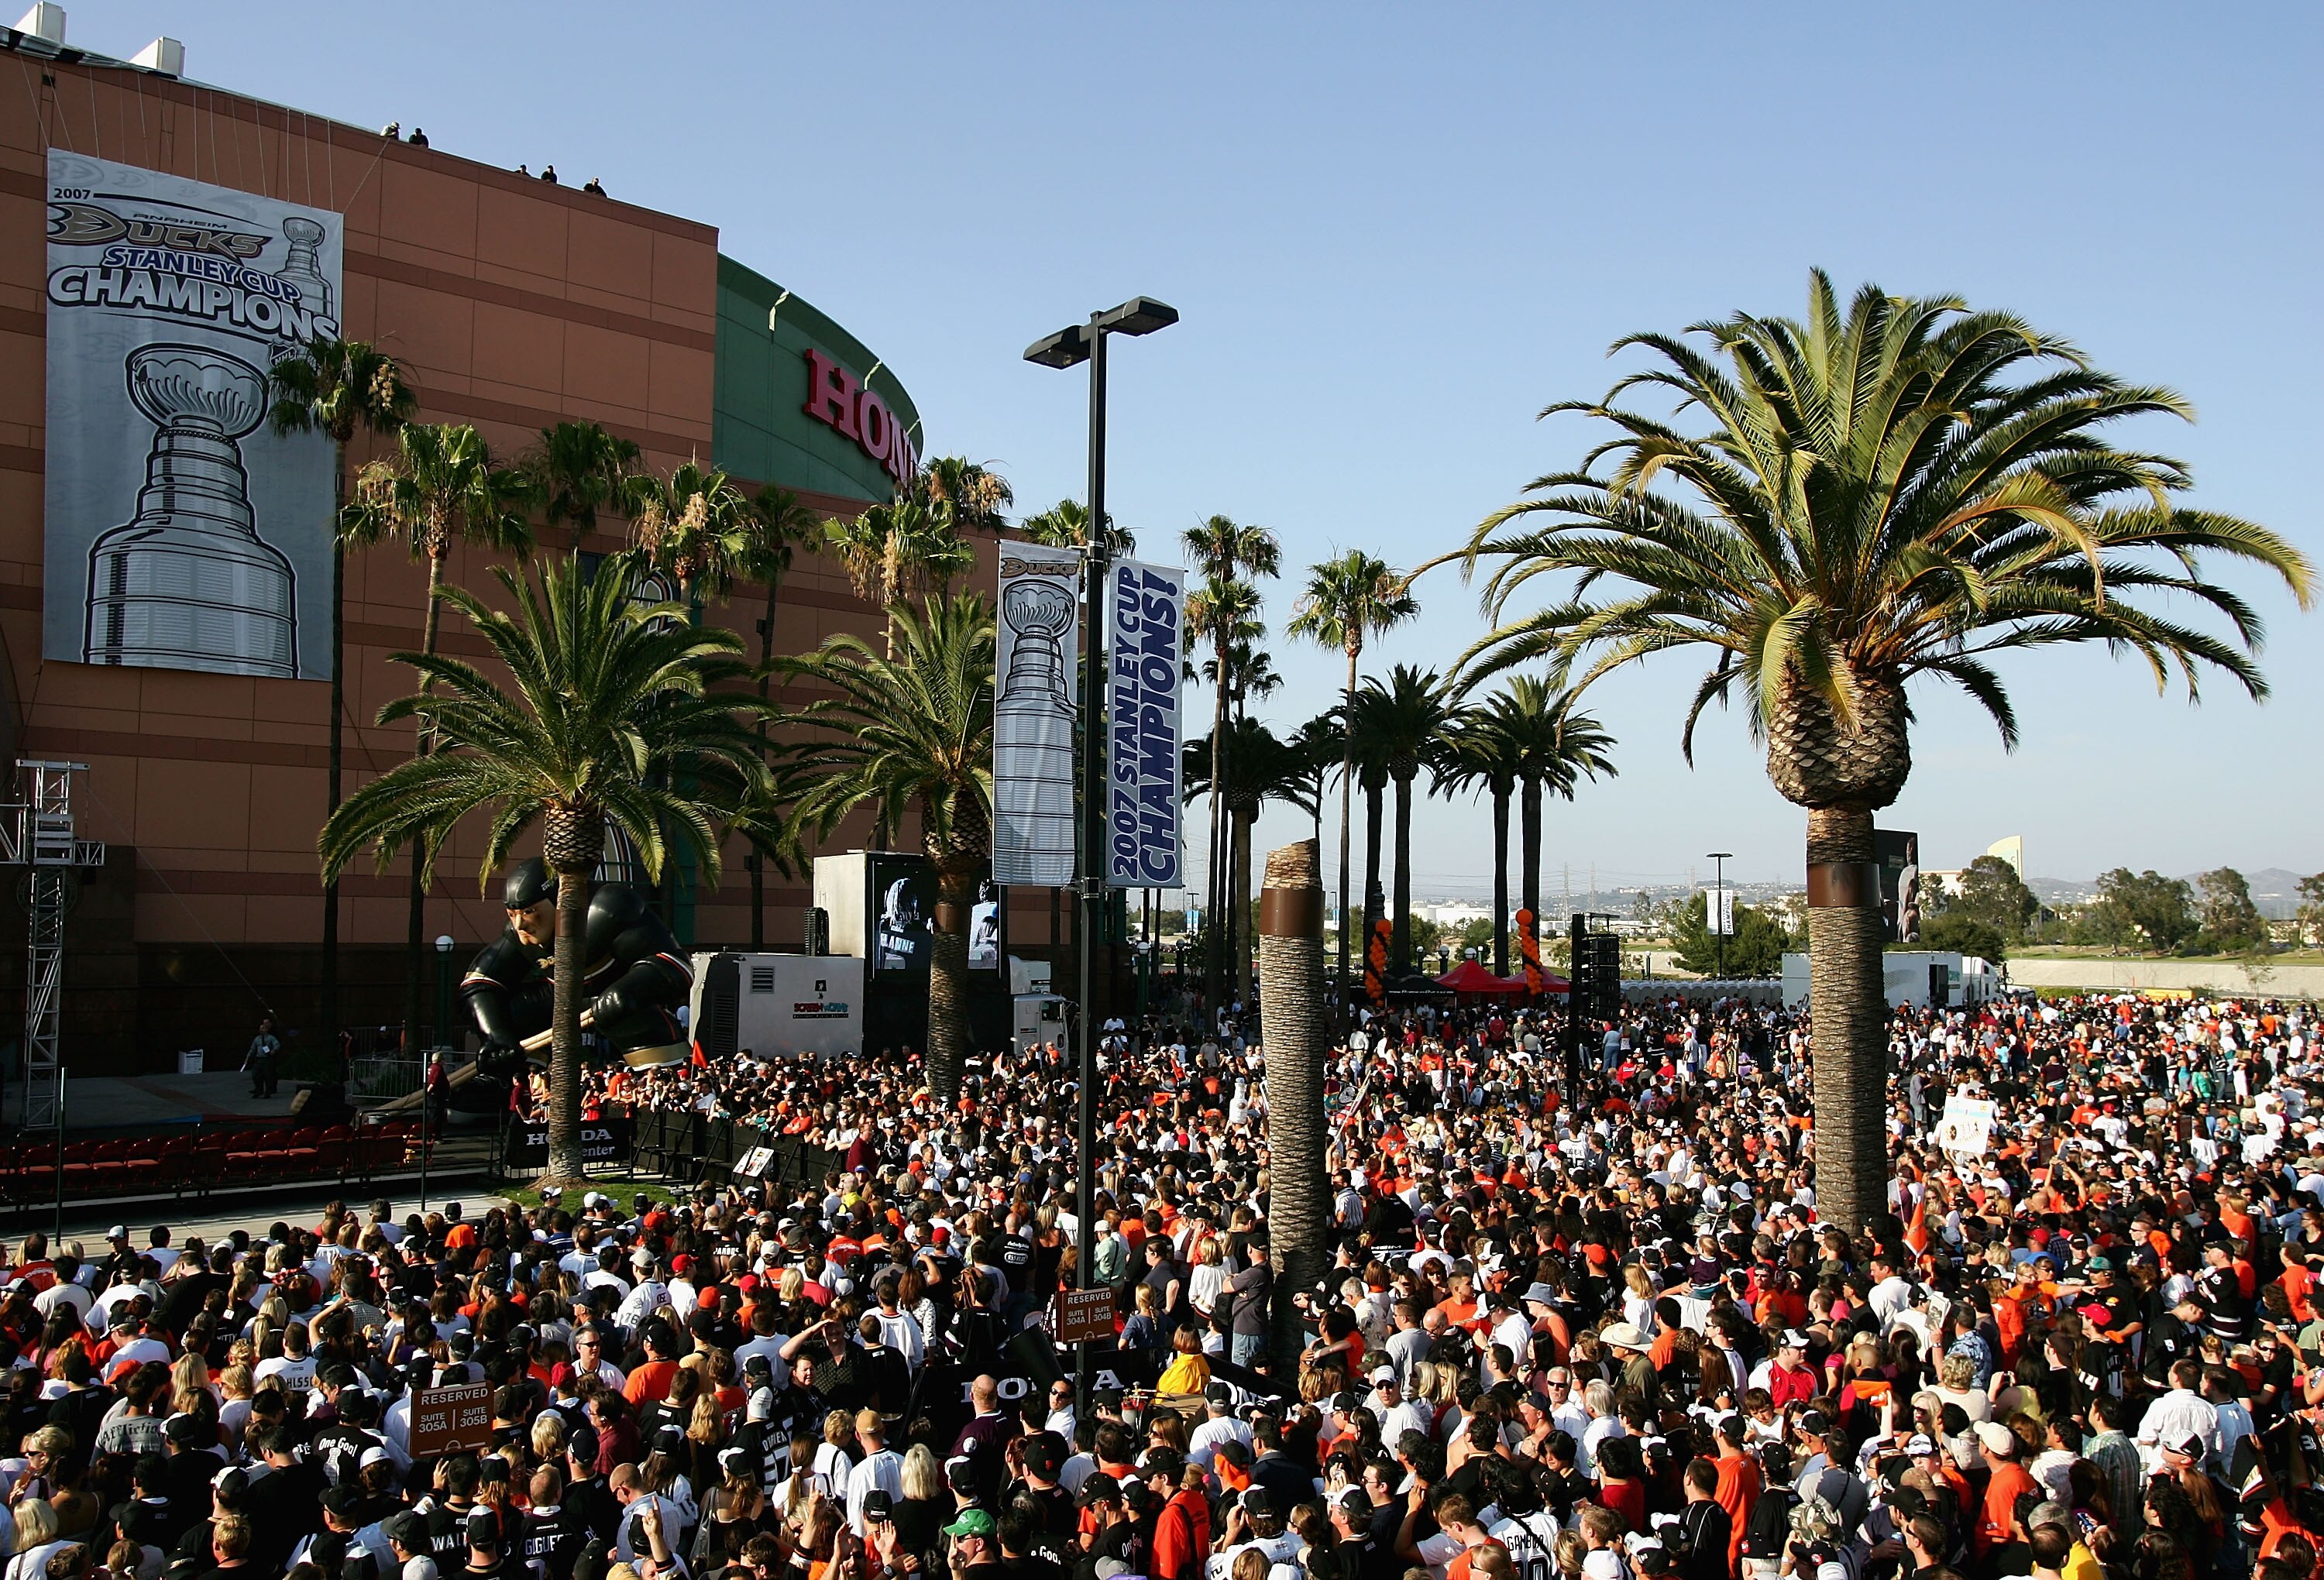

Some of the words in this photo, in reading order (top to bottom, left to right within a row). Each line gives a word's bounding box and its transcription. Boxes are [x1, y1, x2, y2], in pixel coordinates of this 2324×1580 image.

[53, 187, 91, 200] 2007
[133, 213, 228, 228] ANAHEIM
[103, 246, 243, 284] STANLEY
[239, 267, 302, 303] CUP
[48, 266, 339, 342] CHAMPIONS
[1000, 558, 1080, 580] DUCKS
[1116, 566, 1141, 634] CUP
[1113, 633, 1140, 788] STANLEY
[1139, 568, 1178, 882] CHAMPIONS!
[1112, 788, 1140, 881] 2007
[582, 1146, 615, 1156] enter
[1067, 1291, 1112, 1305] RESERVED
[1067, 1309, 1085, 1317] SUITE
[1095, 1305, 1111, 1314] SUITE
[1067, 1316, 1086, 1326] 304A
[1093, 1312, 1112, 1321] 304B
[421, 1389, 488, 1406] RESERVED
[418, 1420, 448, 1434] 305A
[459, 1415, 488, 1427] 305B
[421, 1413, 445, 1423] SUITE
[462, 1407, 486, 1417] SUITE
[318, 1438, 335, 1451] One
[338, 1437, 358, 1458] Goal
[525, 1533, 572, 1555] GIGUE
